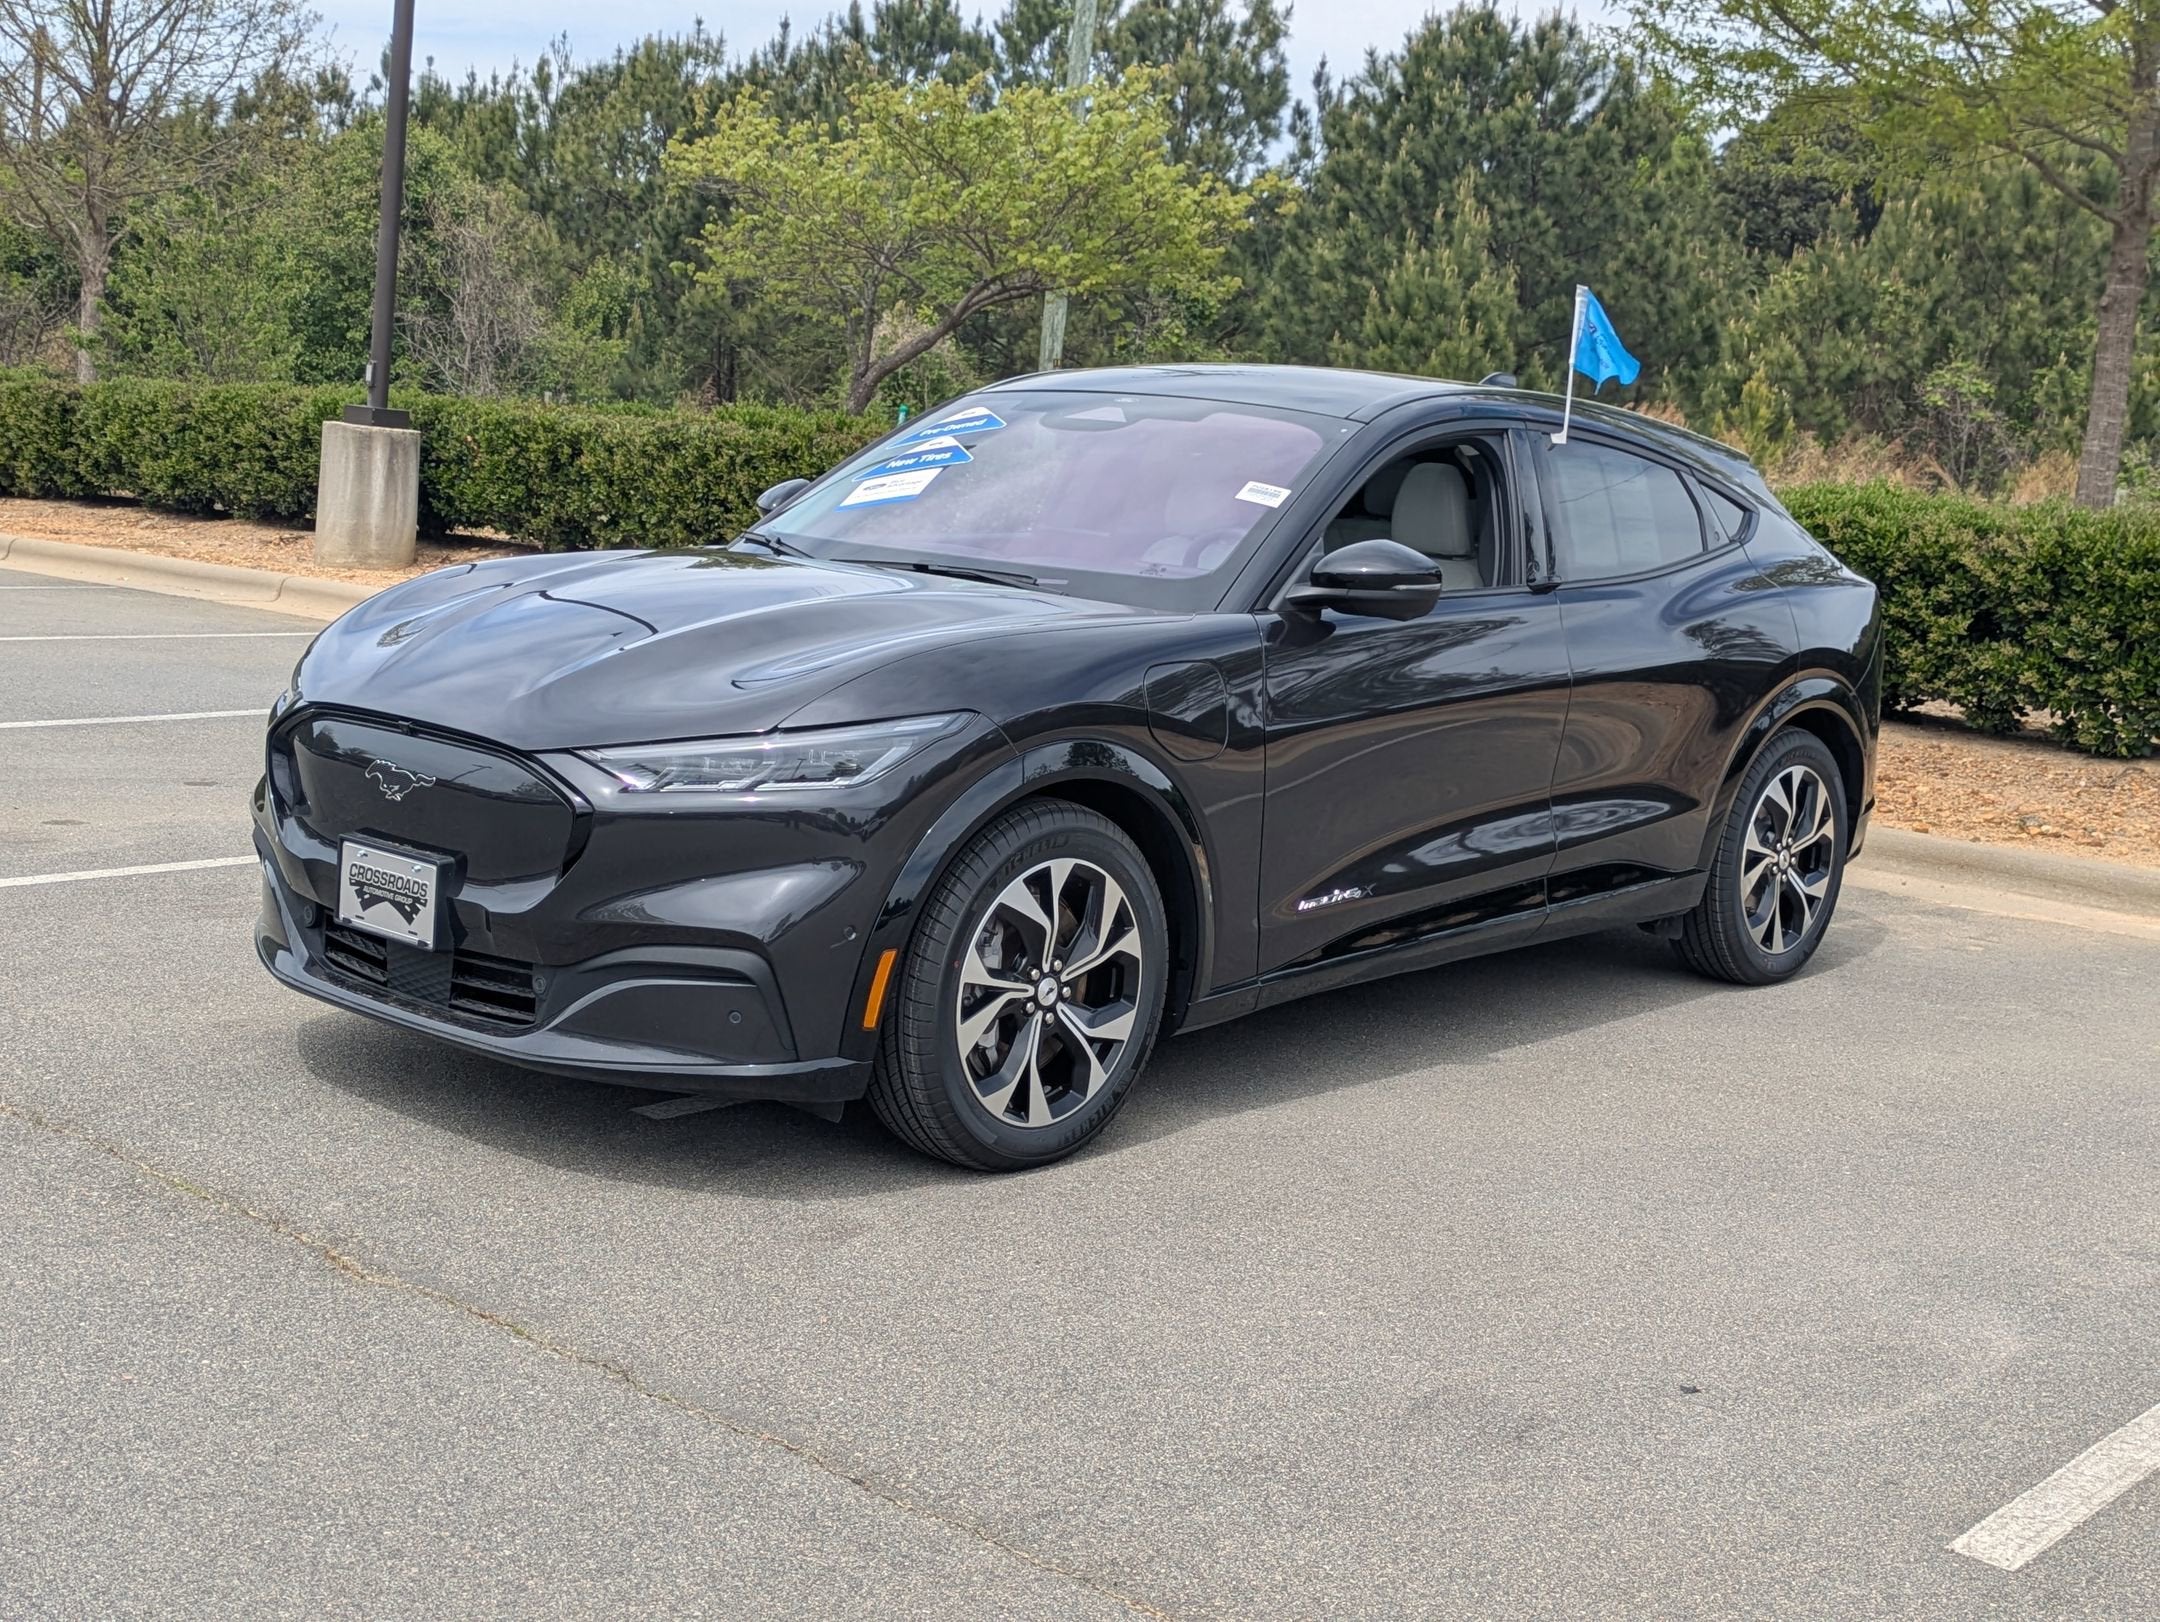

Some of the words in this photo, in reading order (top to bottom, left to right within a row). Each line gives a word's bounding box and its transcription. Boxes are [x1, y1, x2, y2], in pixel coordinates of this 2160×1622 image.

[919, 418, 988, 437] Pre-Owned
[886, 457, 918, 469] New
[920, 452, 953, 463] Tires
[349, 863, 428, 898] CROSSROADS
[363, 885, 395, 900] AUTOMOTIVE
[395, 894, 413, 904] GROUP
